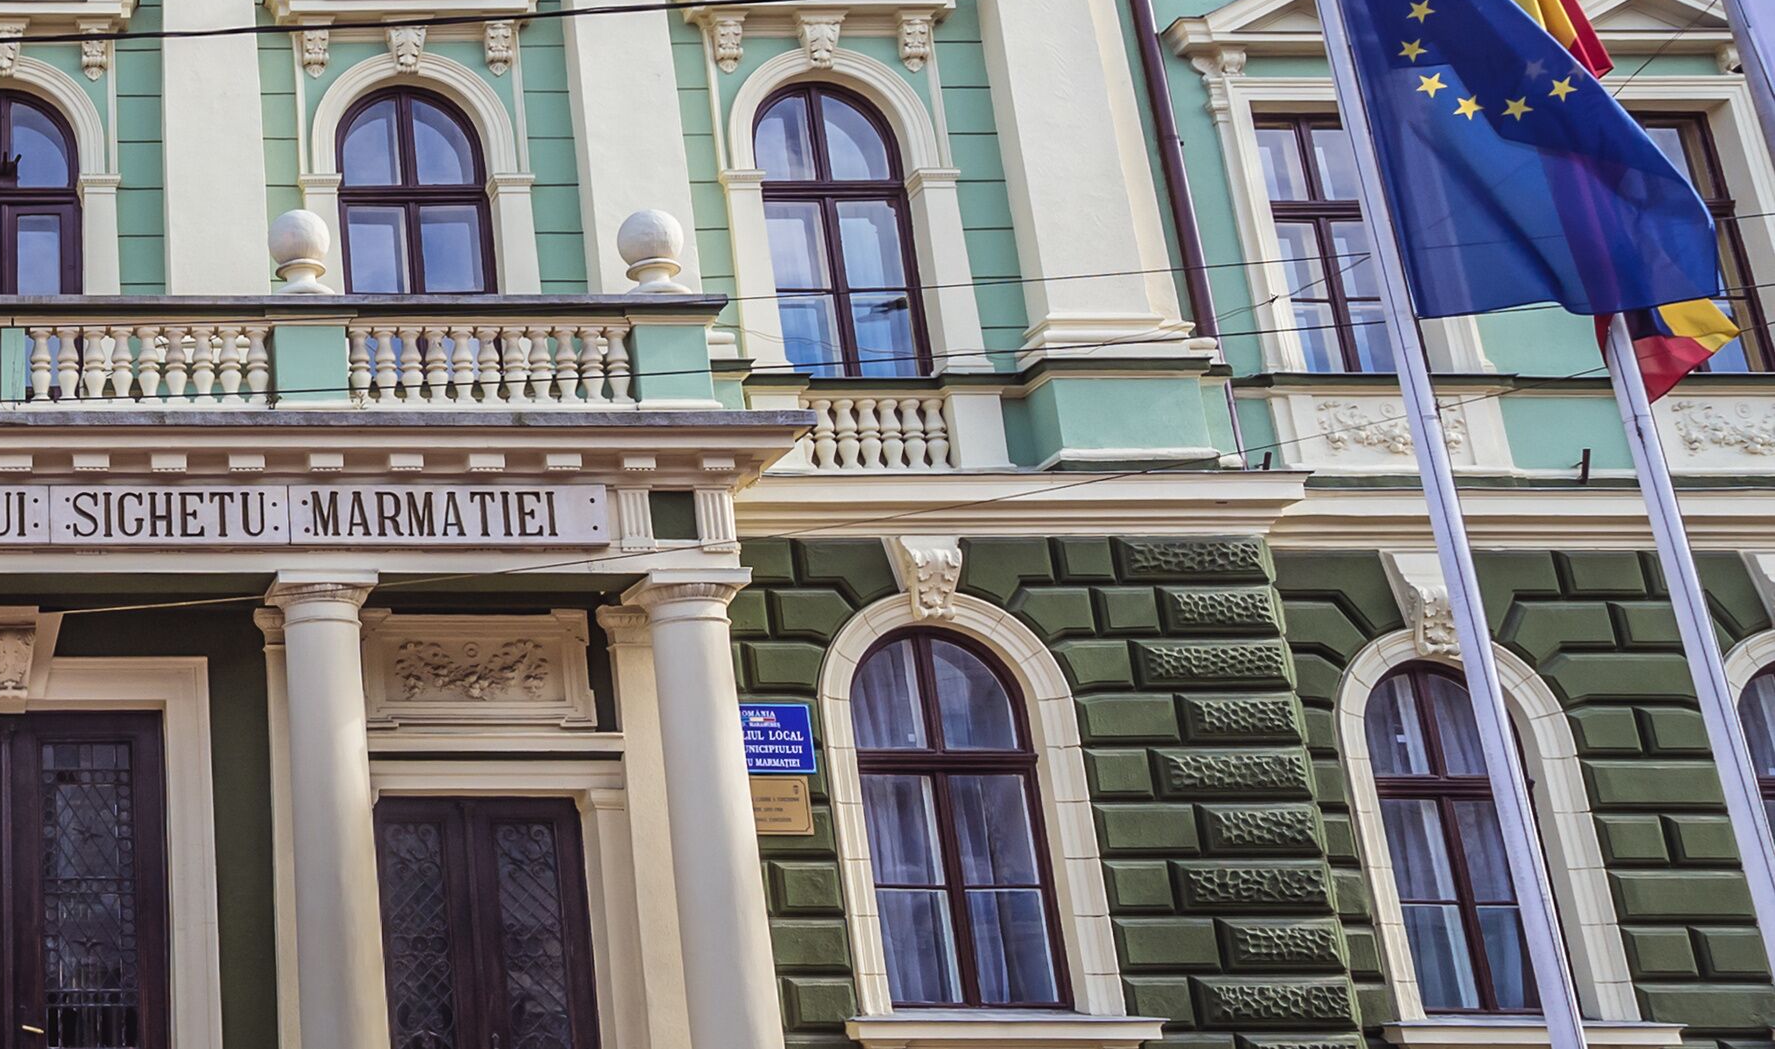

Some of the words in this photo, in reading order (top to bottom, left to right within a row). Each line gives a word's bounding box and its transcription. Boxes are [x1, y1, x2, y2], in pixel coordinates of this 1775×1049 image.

[72, 491, 267, 538] SIGHETU
[311, 490, 558, 538] MARMATIEI
[768, 730, 804, 741] LOCAL
